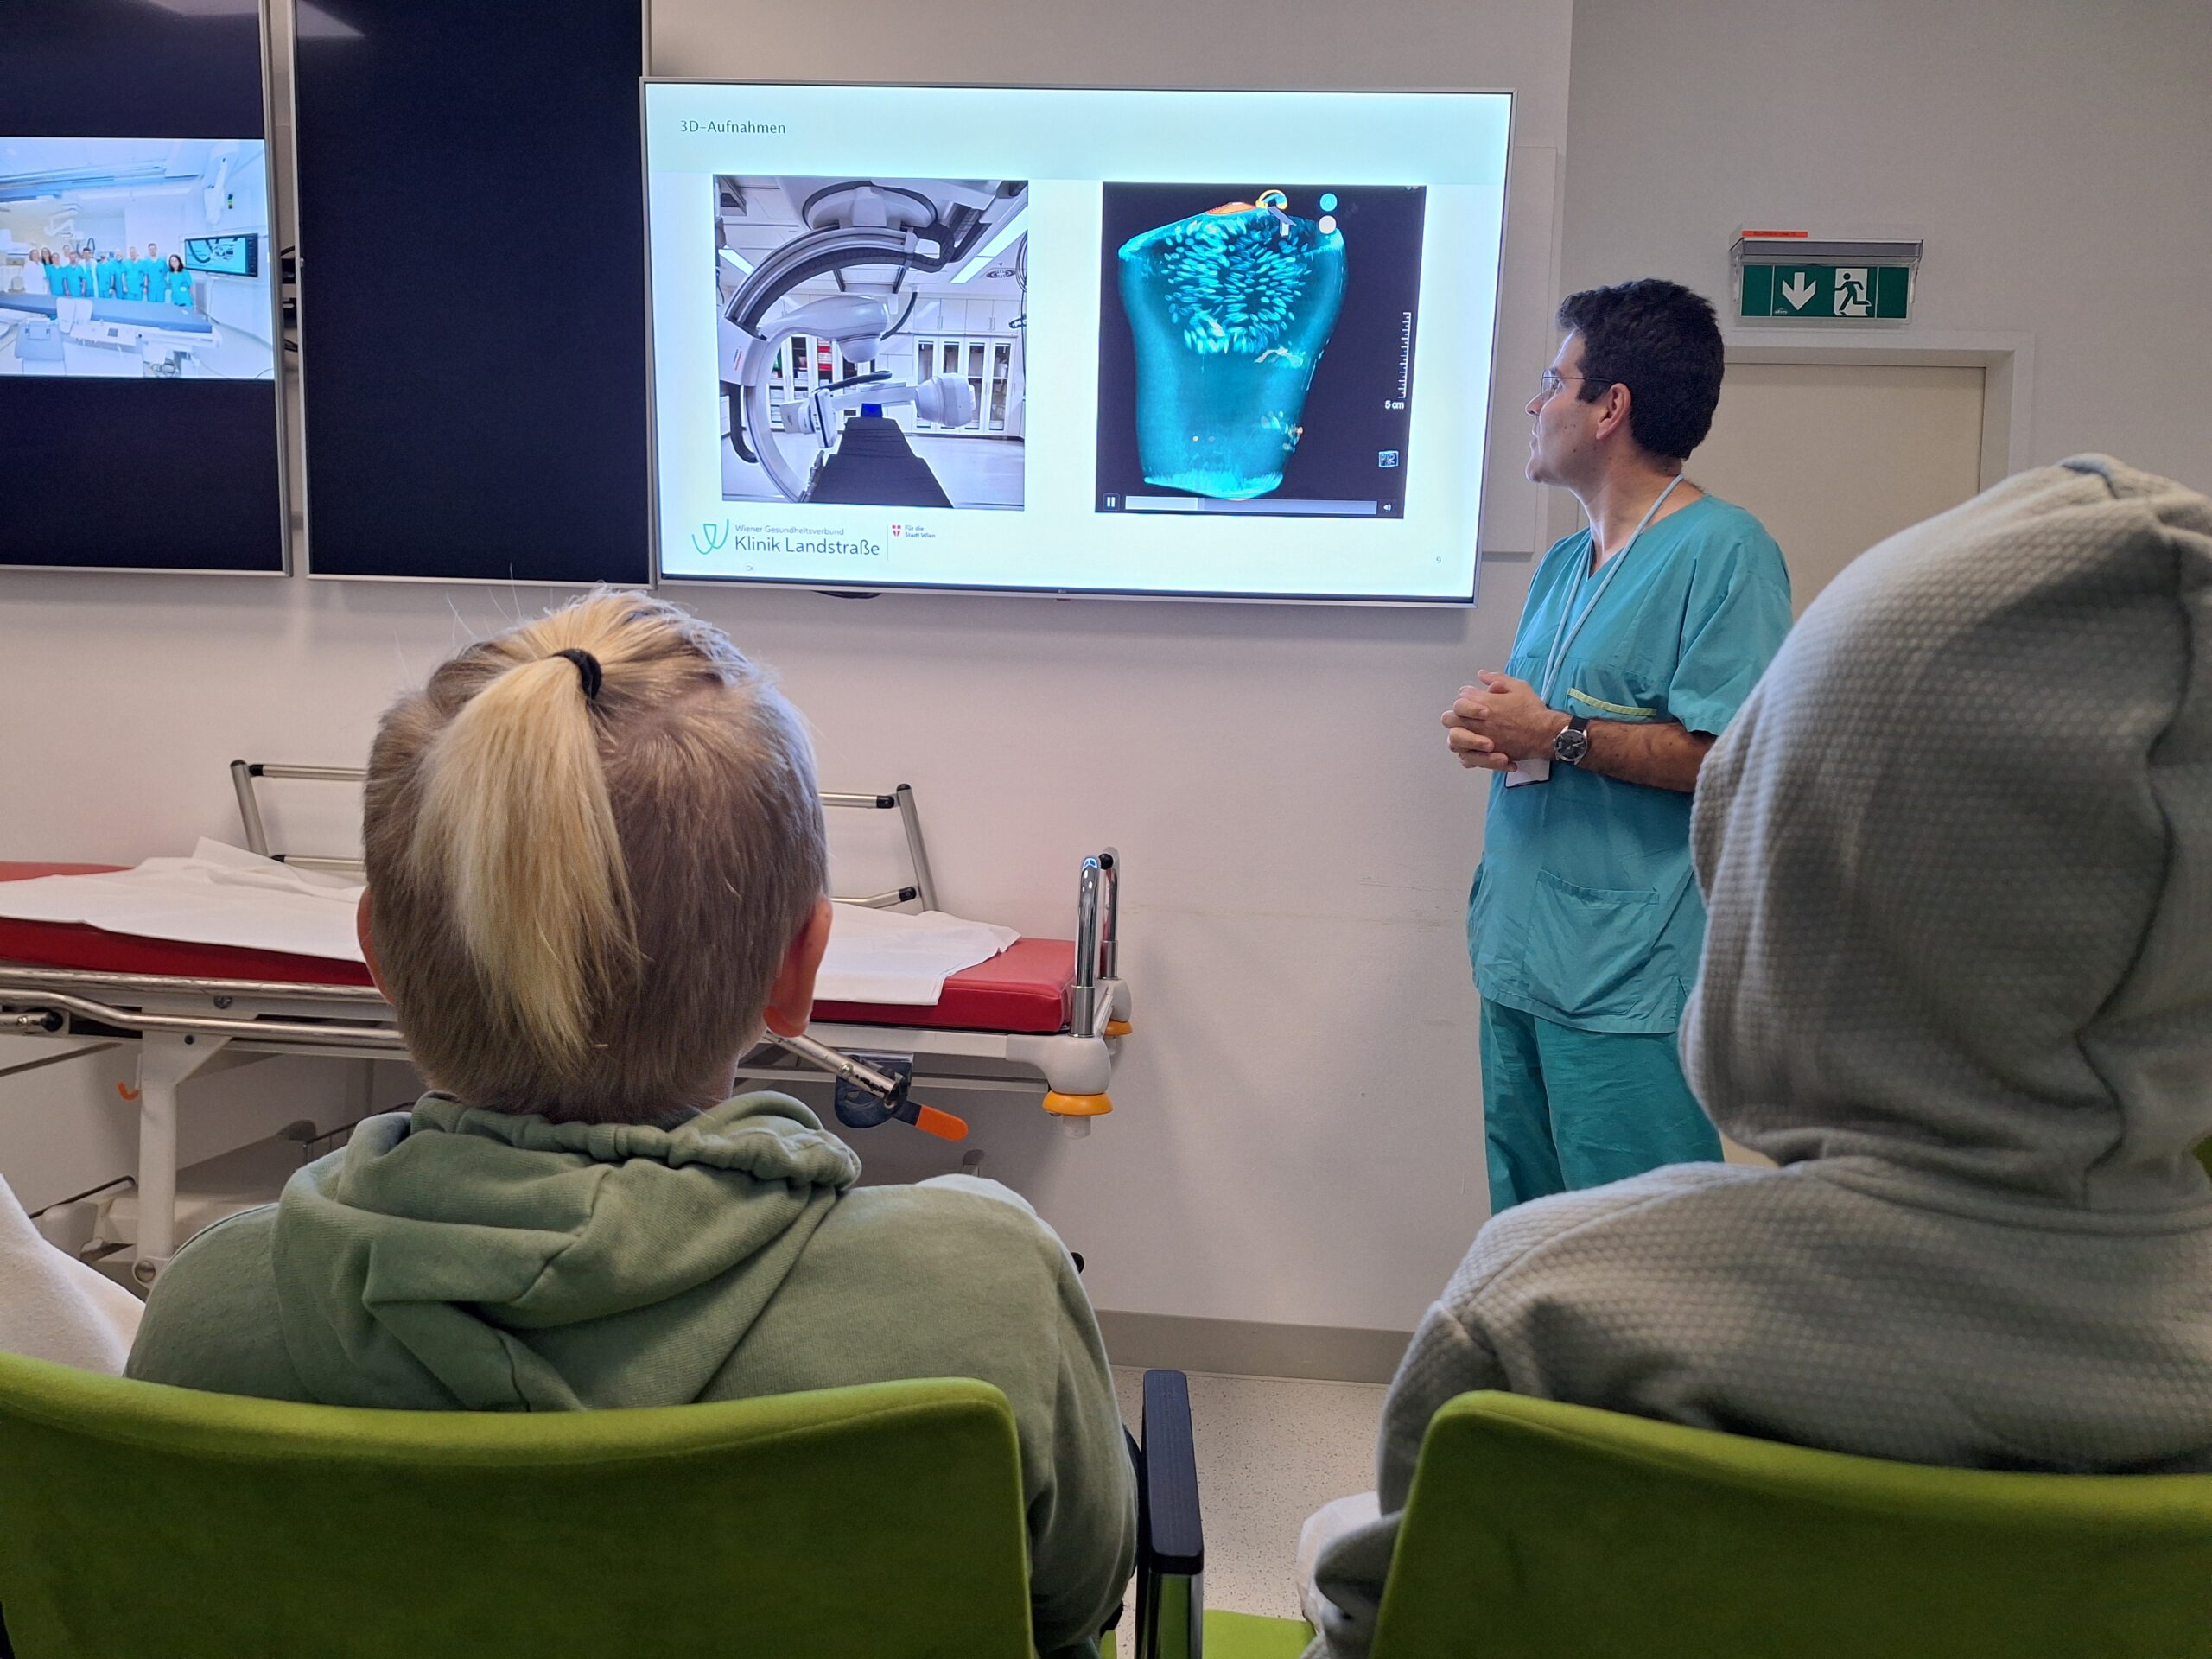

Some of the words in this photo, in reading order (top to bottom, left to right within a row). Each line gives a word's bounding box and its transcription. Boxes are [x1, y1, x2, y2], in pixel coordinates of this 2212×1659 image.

[680, 119, 786, 134] 3D-Aufnahmen
[1384, 399, 1391, 410] 5
[734, 524, 763, 533] Wiener
[764, 524, 844, 536] Gesundheitsverbund
[734, 535, 781, 553] Klinik
[785, 537, 880, 556] Landstraße
